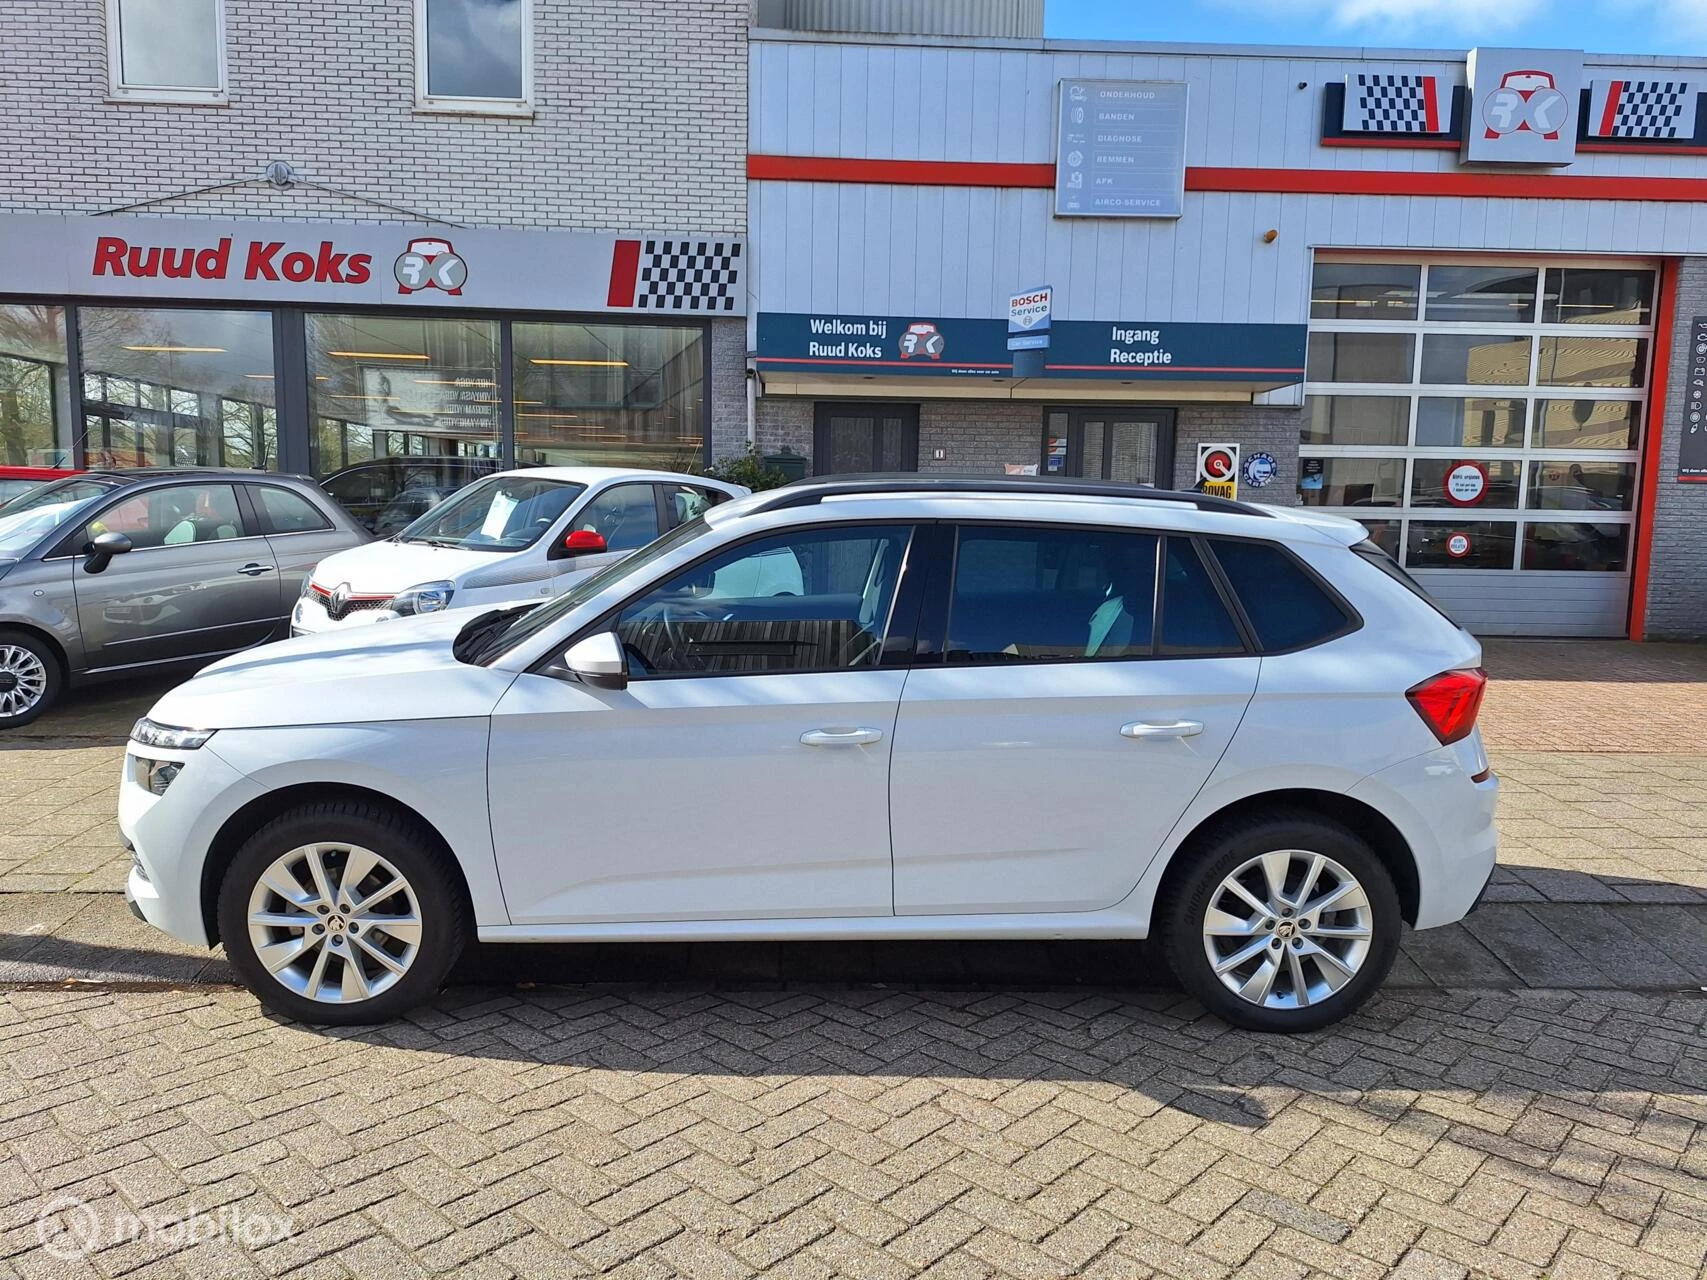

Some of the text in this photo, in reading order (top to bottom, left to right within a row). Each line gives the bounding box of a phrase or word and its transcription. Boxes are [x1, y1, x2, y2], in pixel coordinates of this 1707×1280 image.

[1099, 90, 1156, 100] ONDERHOUD
[1098, 113, 1135, 121] BANDEN
[1097, 135, 1143, 143] DIAGNOSE
[1096, 155, 1135, 163] REMMEN
[1095, 177, 1114, 185] APK
[92, 237, 373, 285] Ruud Koks
[1011, 292, 1048, 308] BOSCH
[1010, 304, 1048, 317] Service
[810, 318, 887, 339] Welkom bij
[1112, 326, 1160, 345] Ingang
[809, 342, 882, 359] Ruud Koks
[1109, 348, 1172, 367] Receptie
